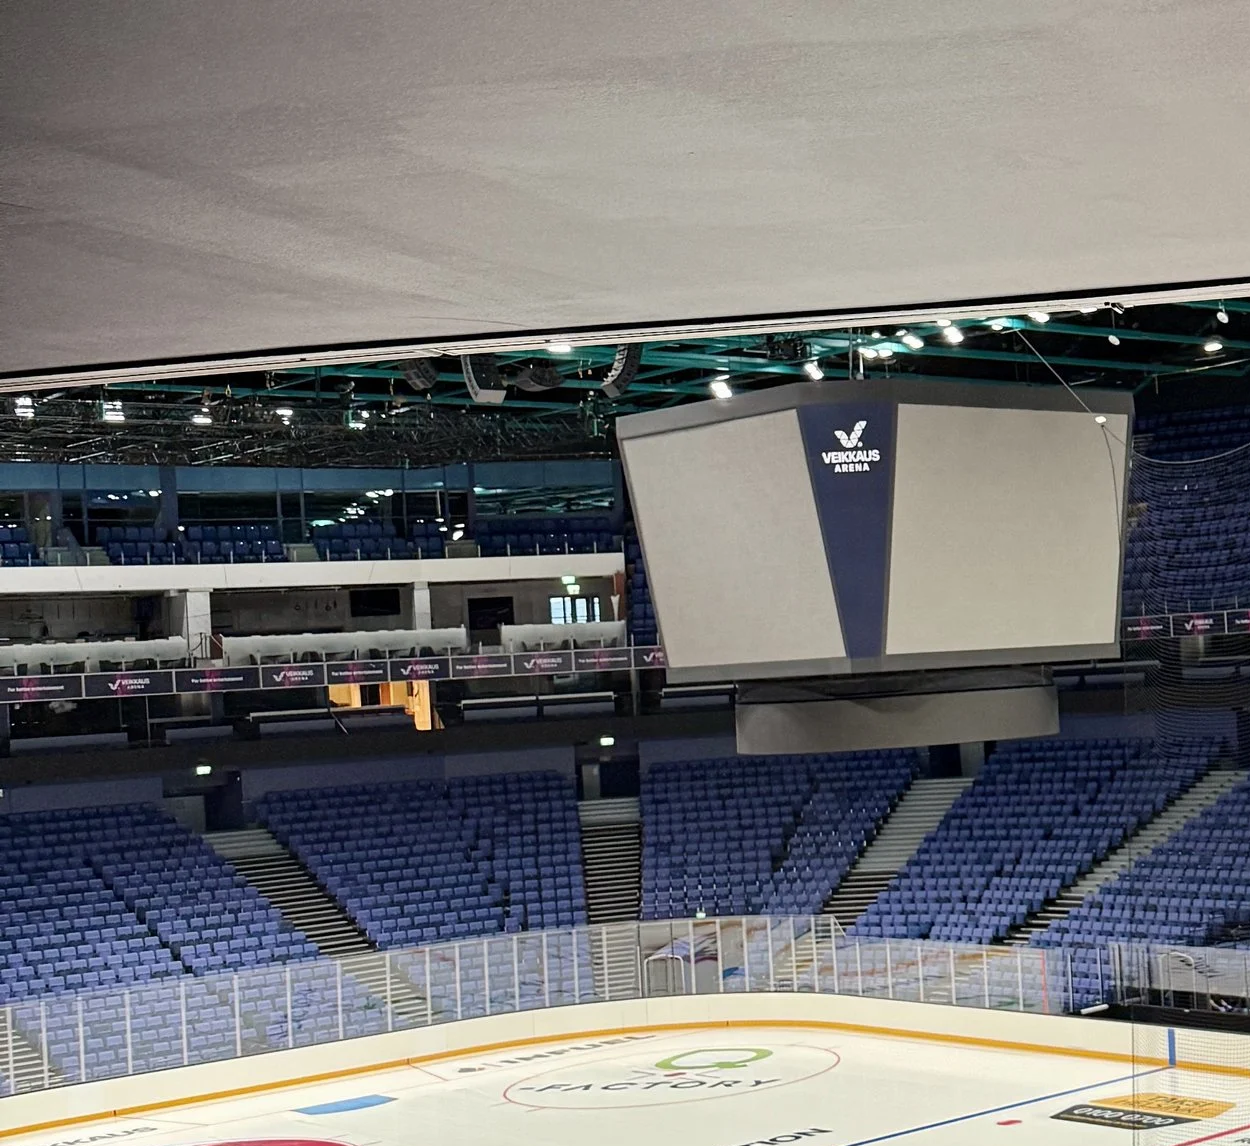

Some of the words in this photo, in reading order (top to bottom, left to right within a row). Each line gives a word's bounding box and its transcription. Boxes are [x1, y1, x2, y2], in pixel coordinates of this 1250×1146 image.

[821, 449, 881, 464] VEIKKAUS
[834, 462, 870, 473] ARENA
[1073, 1107, 1124, 1119] 0100
